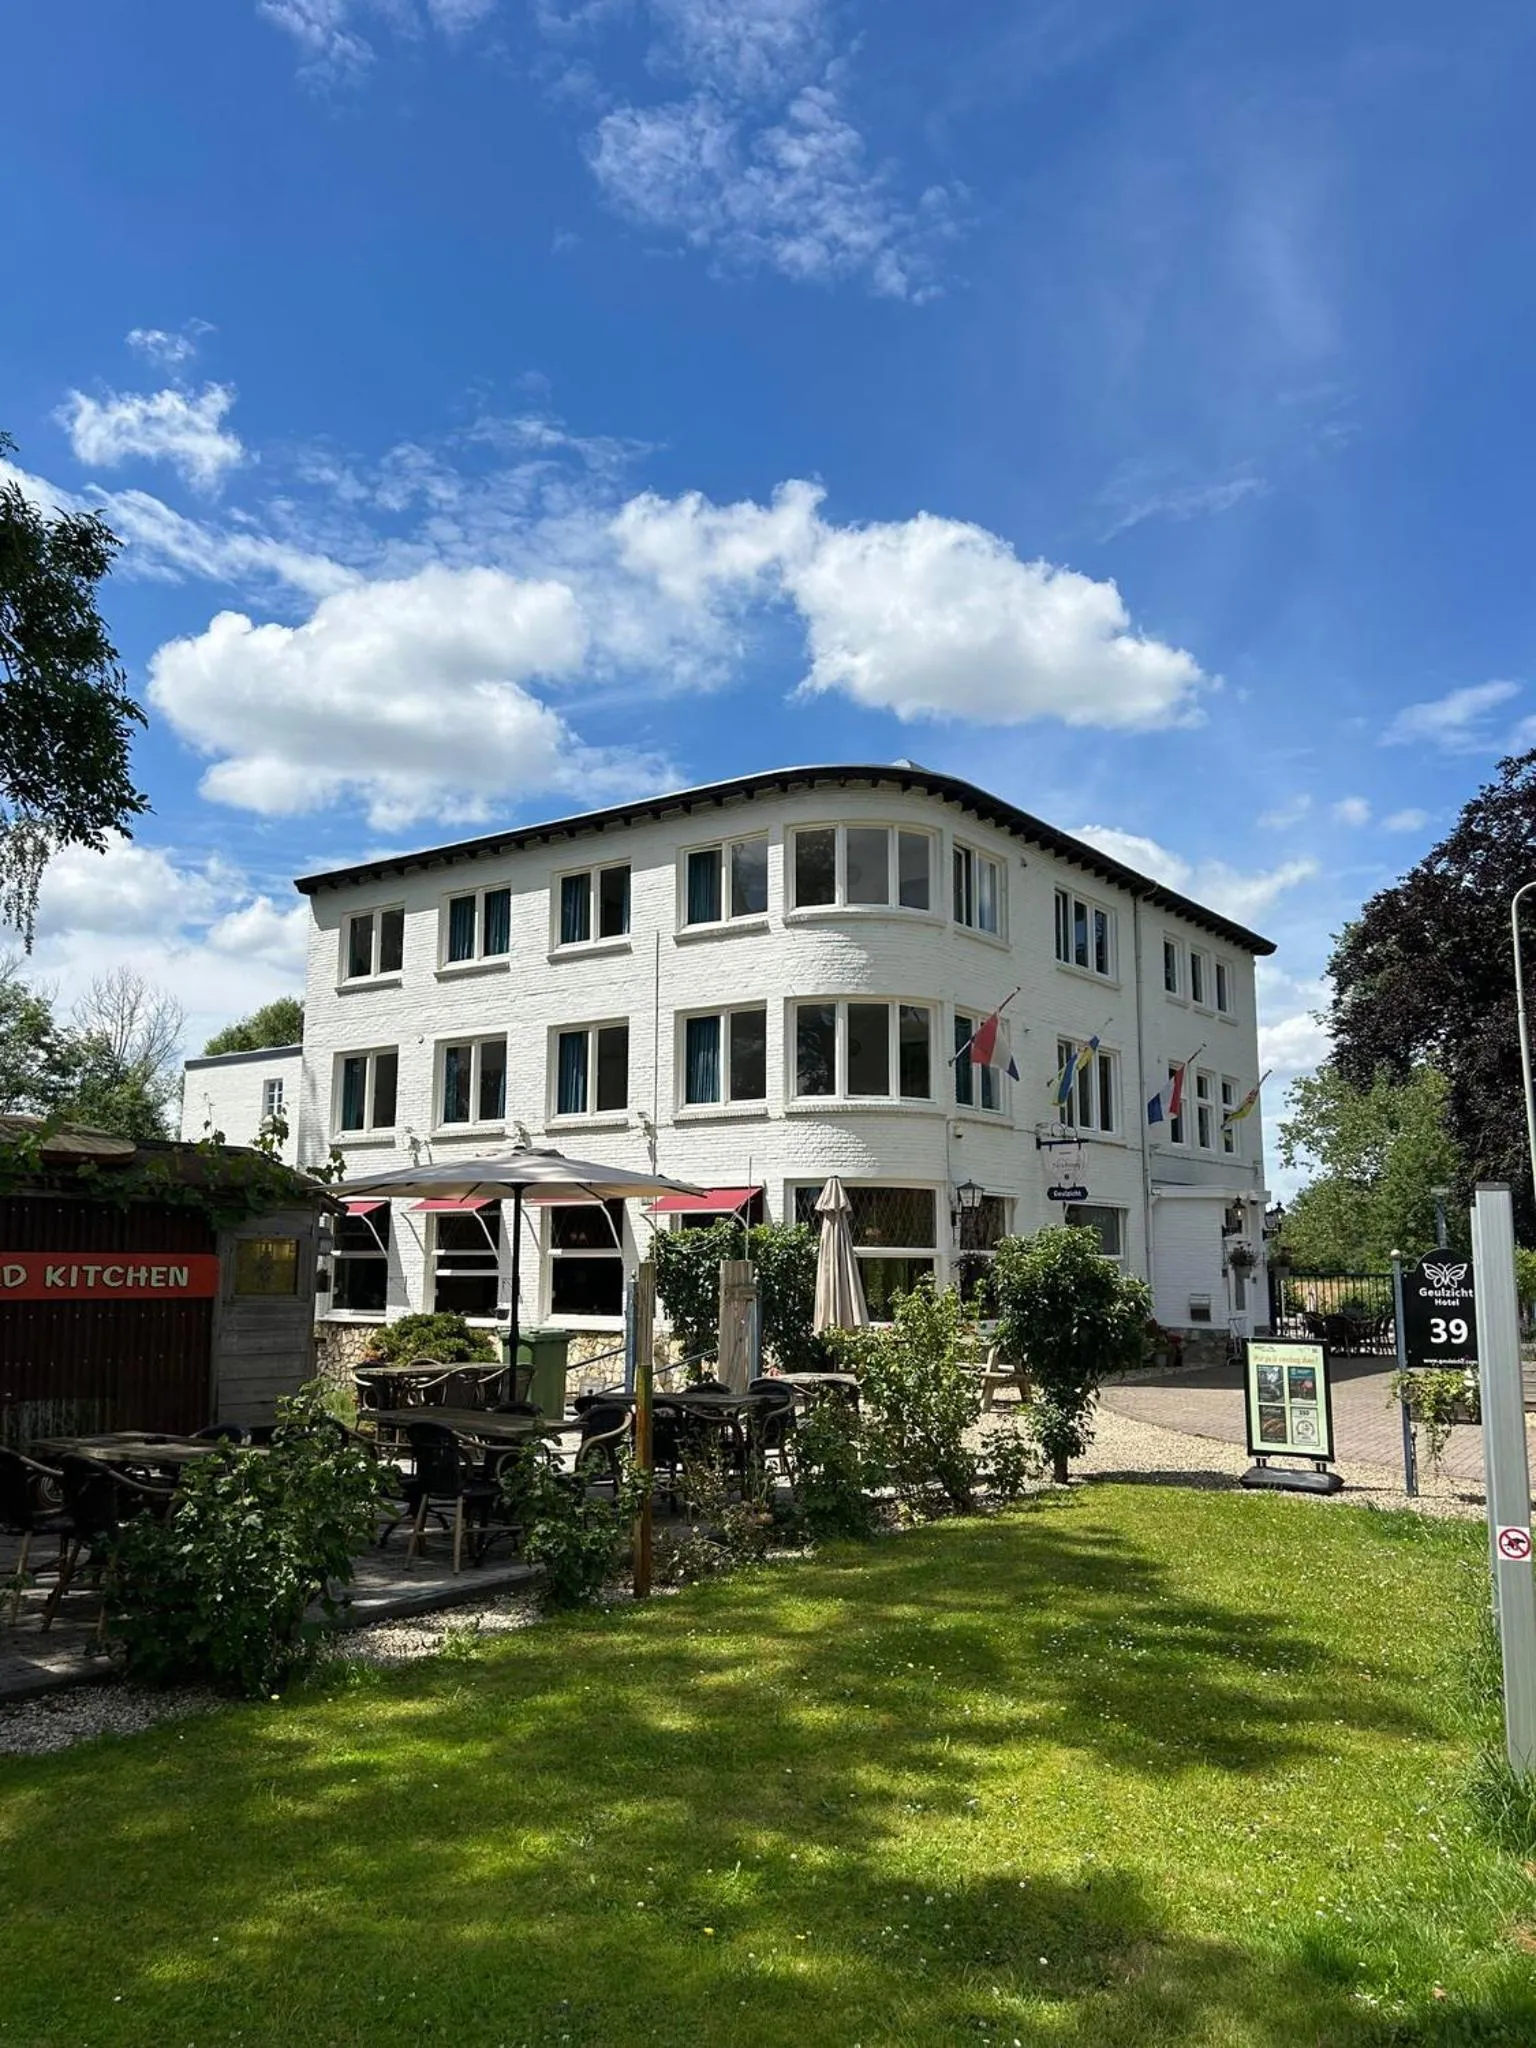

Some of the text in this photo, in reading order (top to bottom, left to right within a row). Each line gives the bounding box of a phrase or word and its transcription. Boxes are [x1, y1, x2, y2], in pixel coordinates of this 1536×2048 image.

[0, 1264, 190, 1288] D KITCHEN
[1418, 1287, 1474, 1298] Geulzicht
[1434, 1298, 1460, 1306] Hotel
[1430, 1318, 1469, 1344] 39
